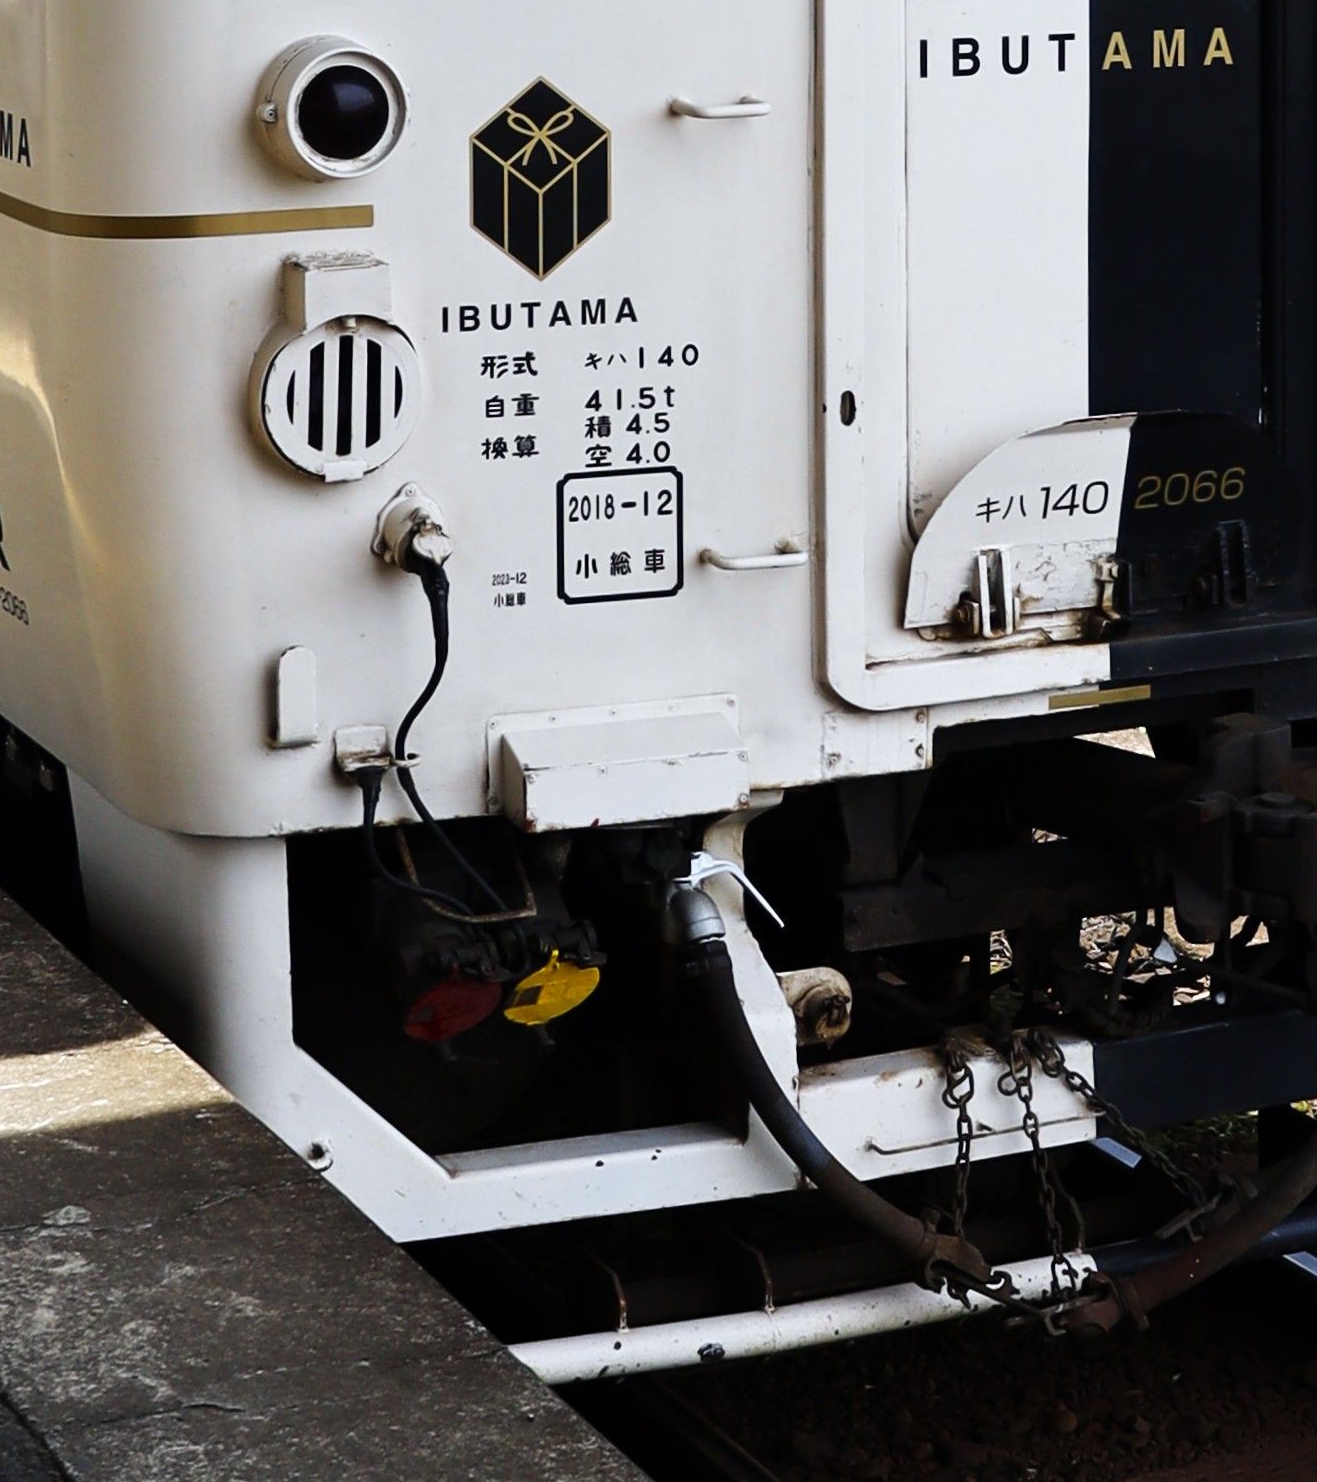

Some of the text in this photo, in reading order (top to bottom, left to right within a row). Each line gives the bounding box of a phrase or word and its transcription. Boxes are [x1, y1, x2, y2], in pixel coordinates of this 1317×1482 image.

[919, 27, 1234, 78] IBUTAMA
[441, 297, 638, 333] IBUTAMA
[481, 351, 538, 379] 形式
[485, 393, 539, 418] 自重
[626, 412, 671, 436] 4.5
[481, 434, 540, 460] 換算
[626, 440, 671, 465] 4.0
[1134, 467, 1246, 510] 2066
[568, 489, 673, 522] 2018-12
[575, 548, 666, 579] 小総車
